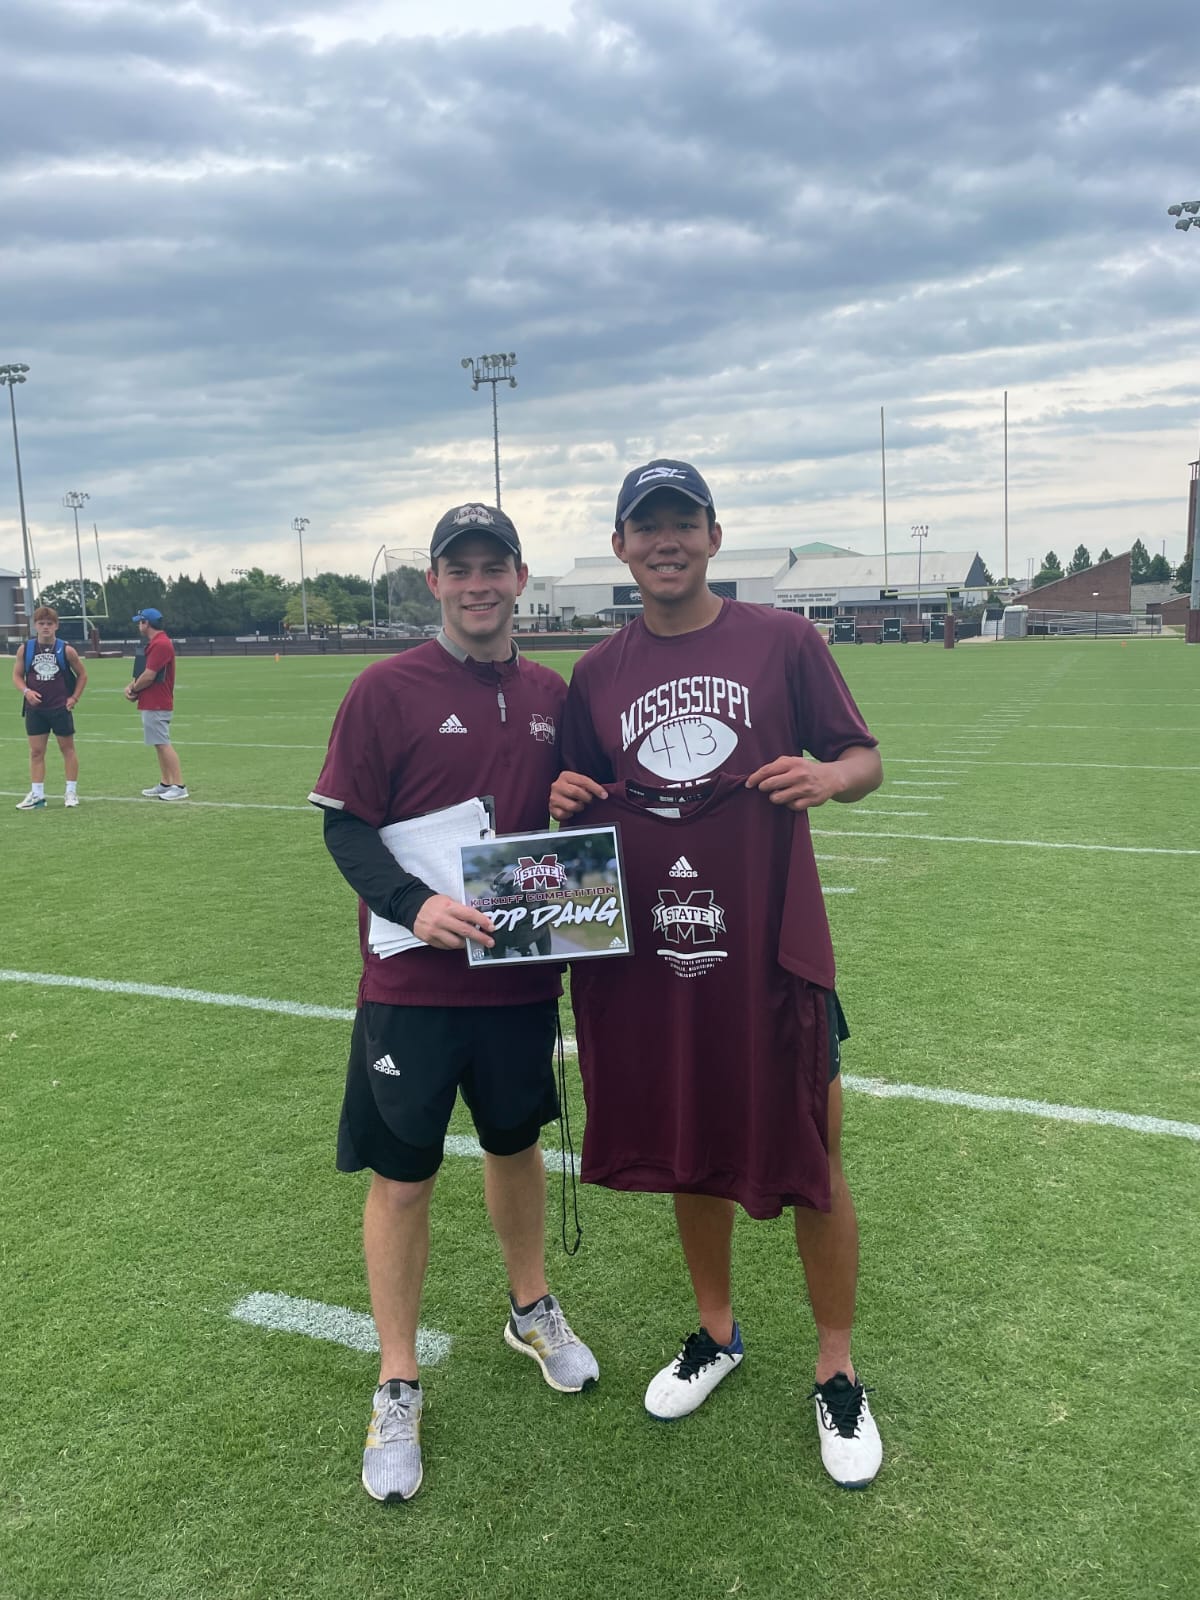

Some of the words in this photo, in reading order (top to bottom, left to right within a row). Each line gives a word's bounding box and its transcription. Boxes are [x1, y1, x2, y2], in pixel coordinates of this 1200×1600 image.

[620, 675, 752, 752] MISSISSIPPI
[439, 726, 468, 734] adidas
[648, 720, 718, 769] 413
[522, 866, 557, 878] STATE
[668, 869, 698, 878] adidas
[470, 895, 523, 907] KICKOFF
[525, 886, 615, 903] COMPETITION
[530, 896, 620, 930] DAWG
[666, 907, 709, 923] STATE
[373, 1063, 401, 1076] adidas
